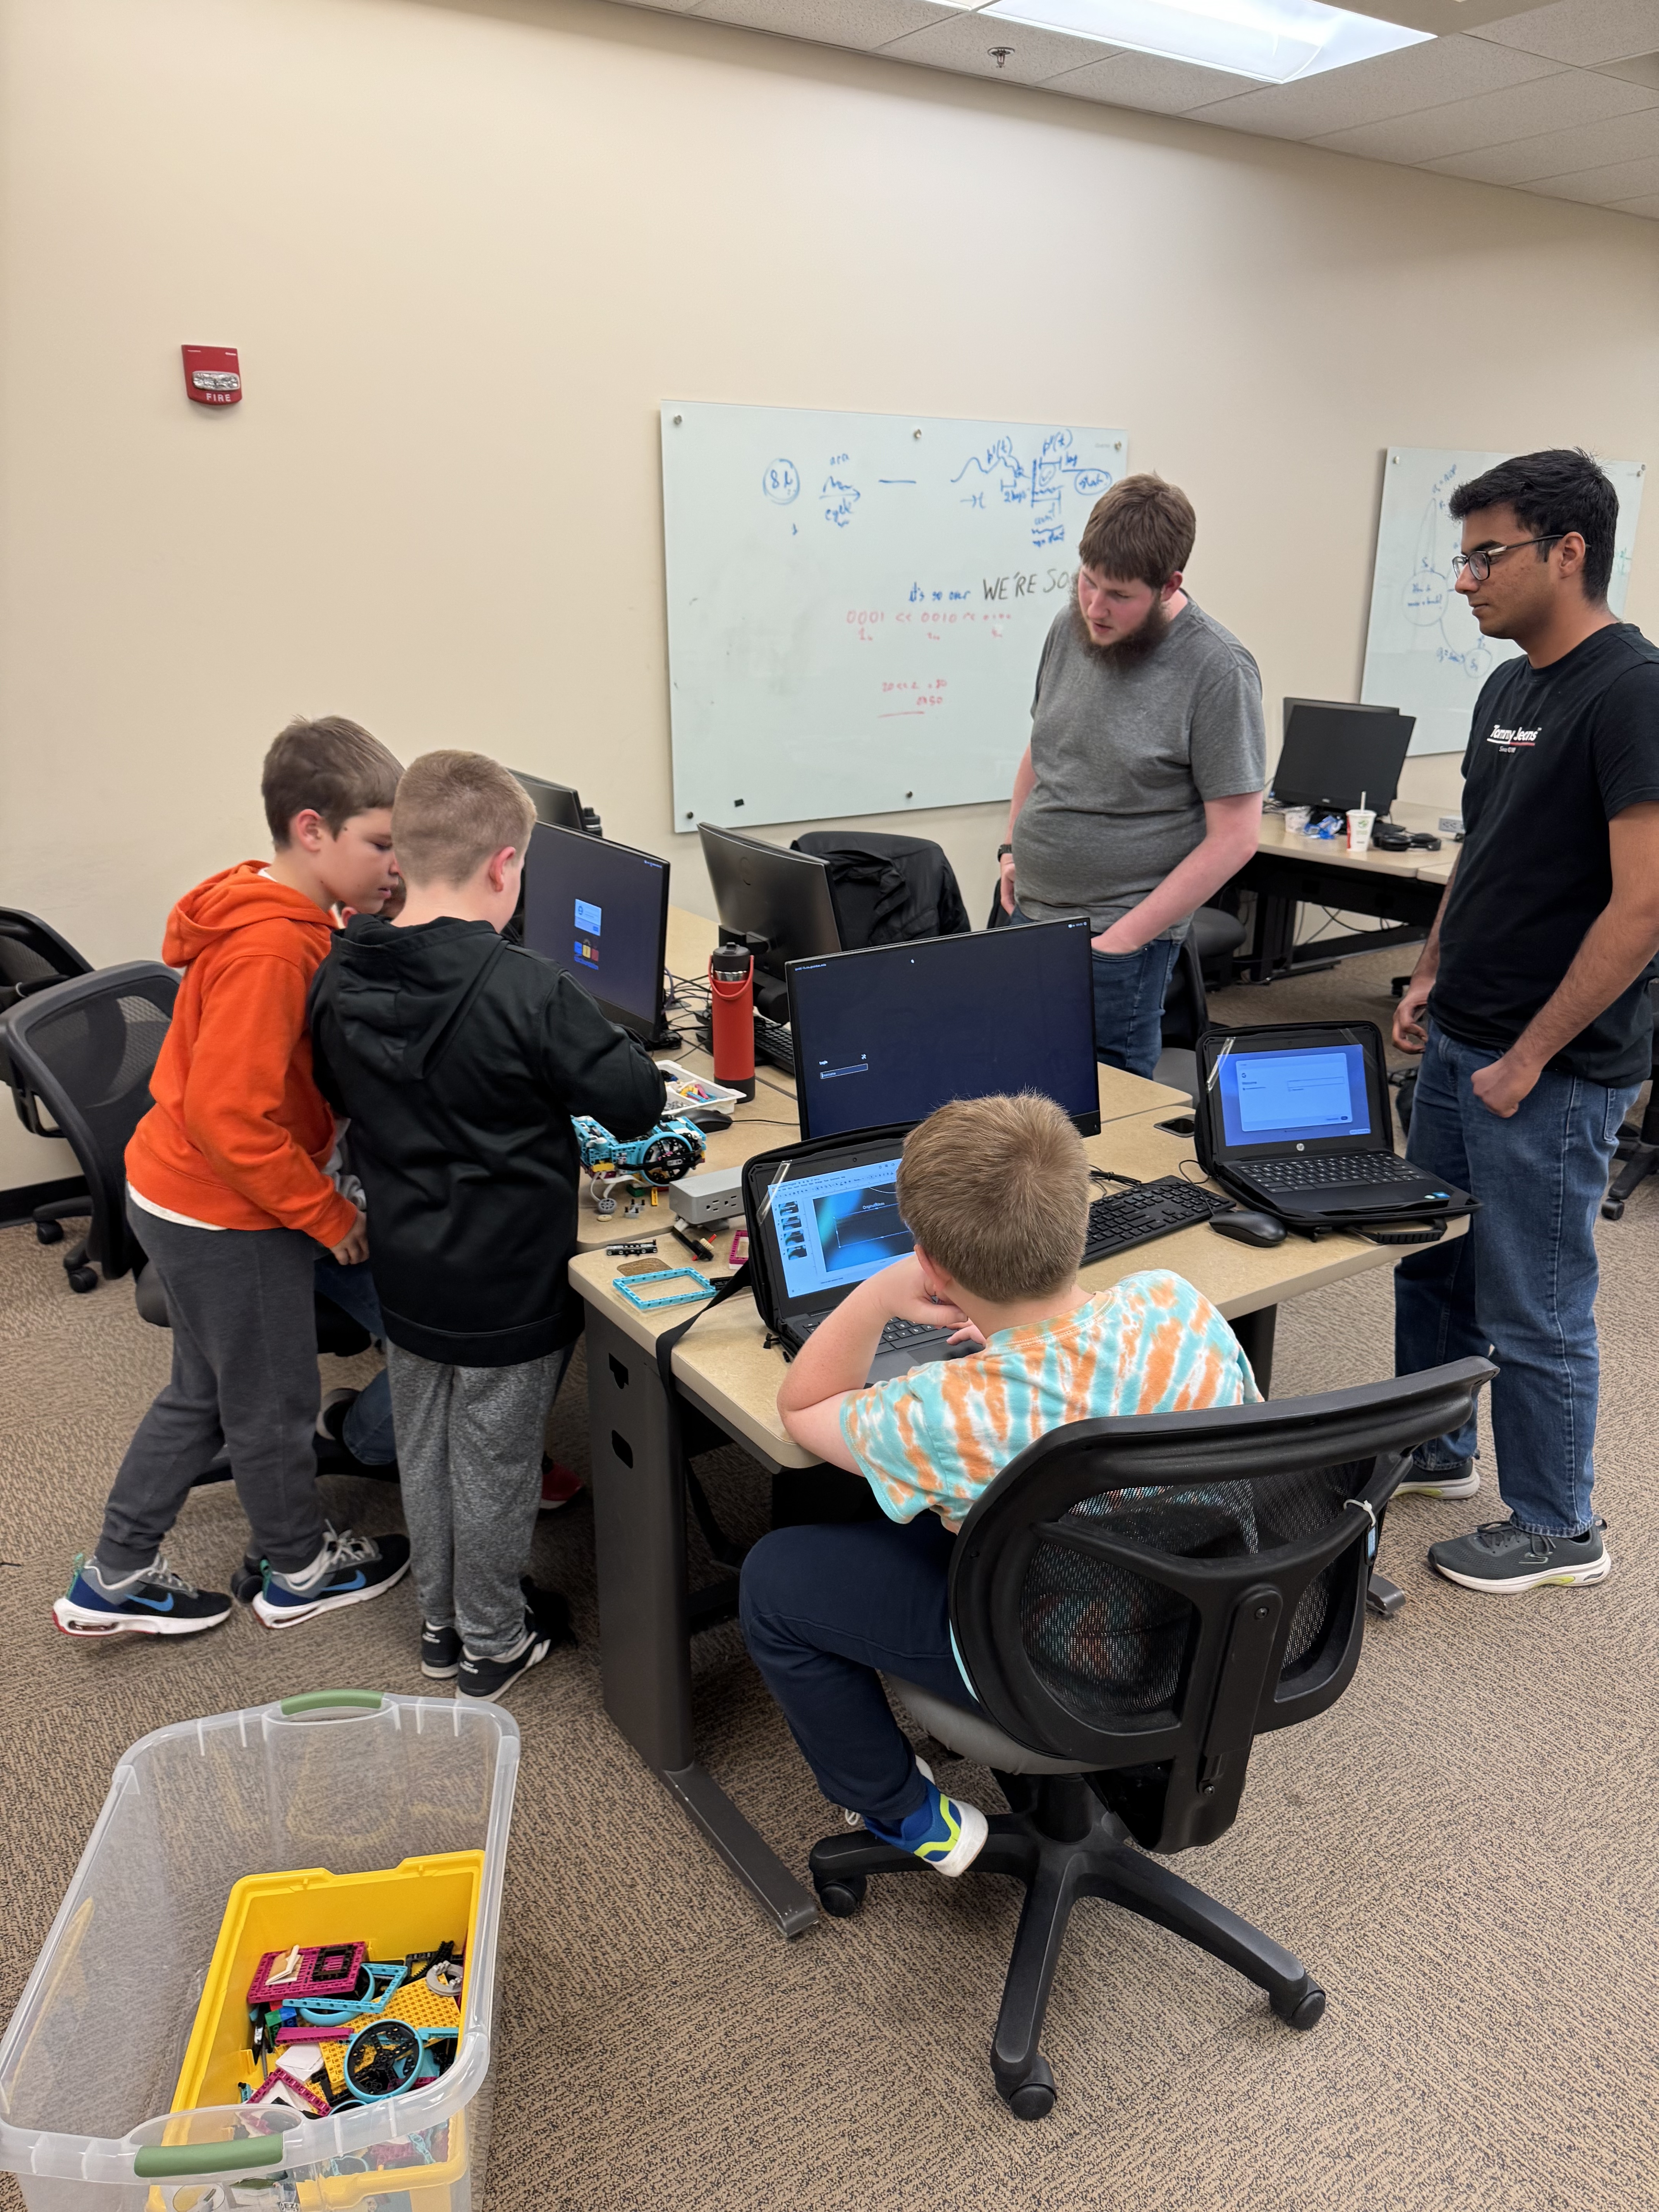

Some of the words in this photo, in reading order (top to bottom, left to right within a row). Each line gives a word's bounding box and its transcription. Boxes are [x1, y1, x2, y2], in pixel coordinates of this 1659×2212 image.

[206, 393, 231, 402] FIRE
[983, 571, 1037, 601] WE'RE
[1043, 568, 1069, 593] SO
[1490, 725, 1516, 743] Tommy
